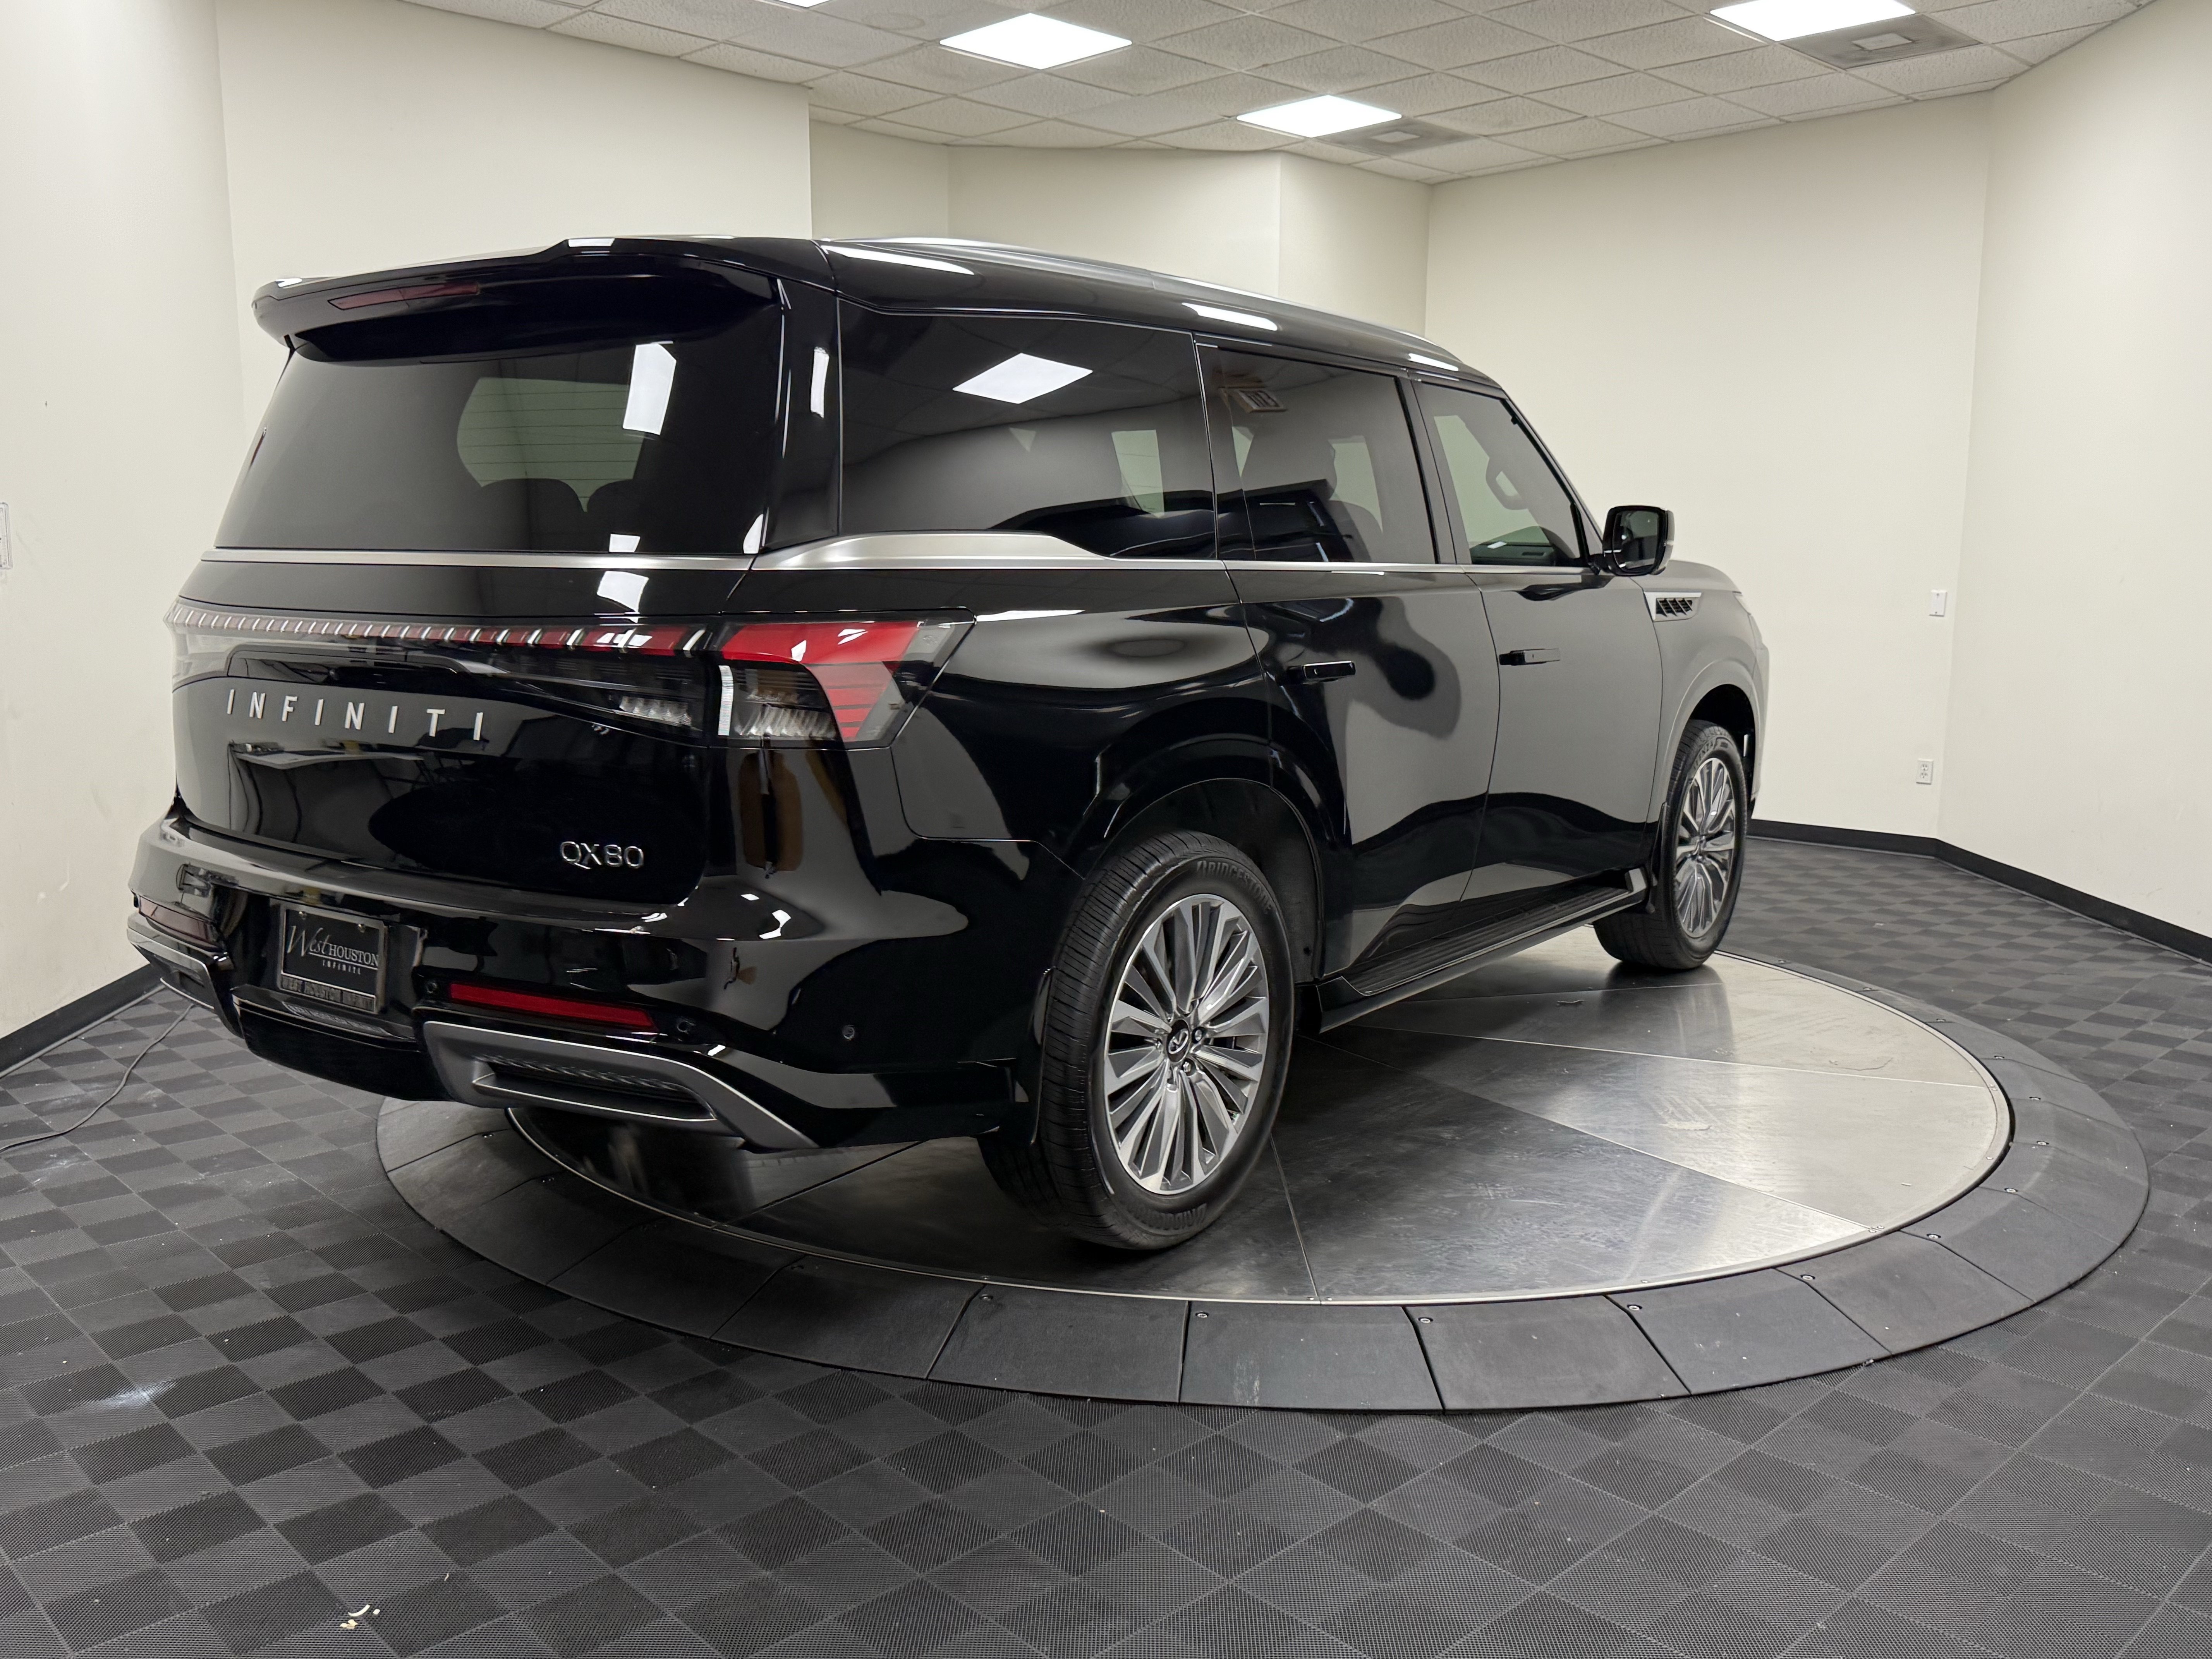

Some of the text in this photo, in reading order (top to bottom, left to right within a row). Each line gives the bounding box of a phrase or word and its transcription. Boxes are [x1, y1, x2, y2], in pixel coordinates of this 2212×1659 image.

[225, 689, 484, 740] INFINITI
[560, 841, 644, 869] QX80
[287, 925, 378, 967] West HOUSTON
